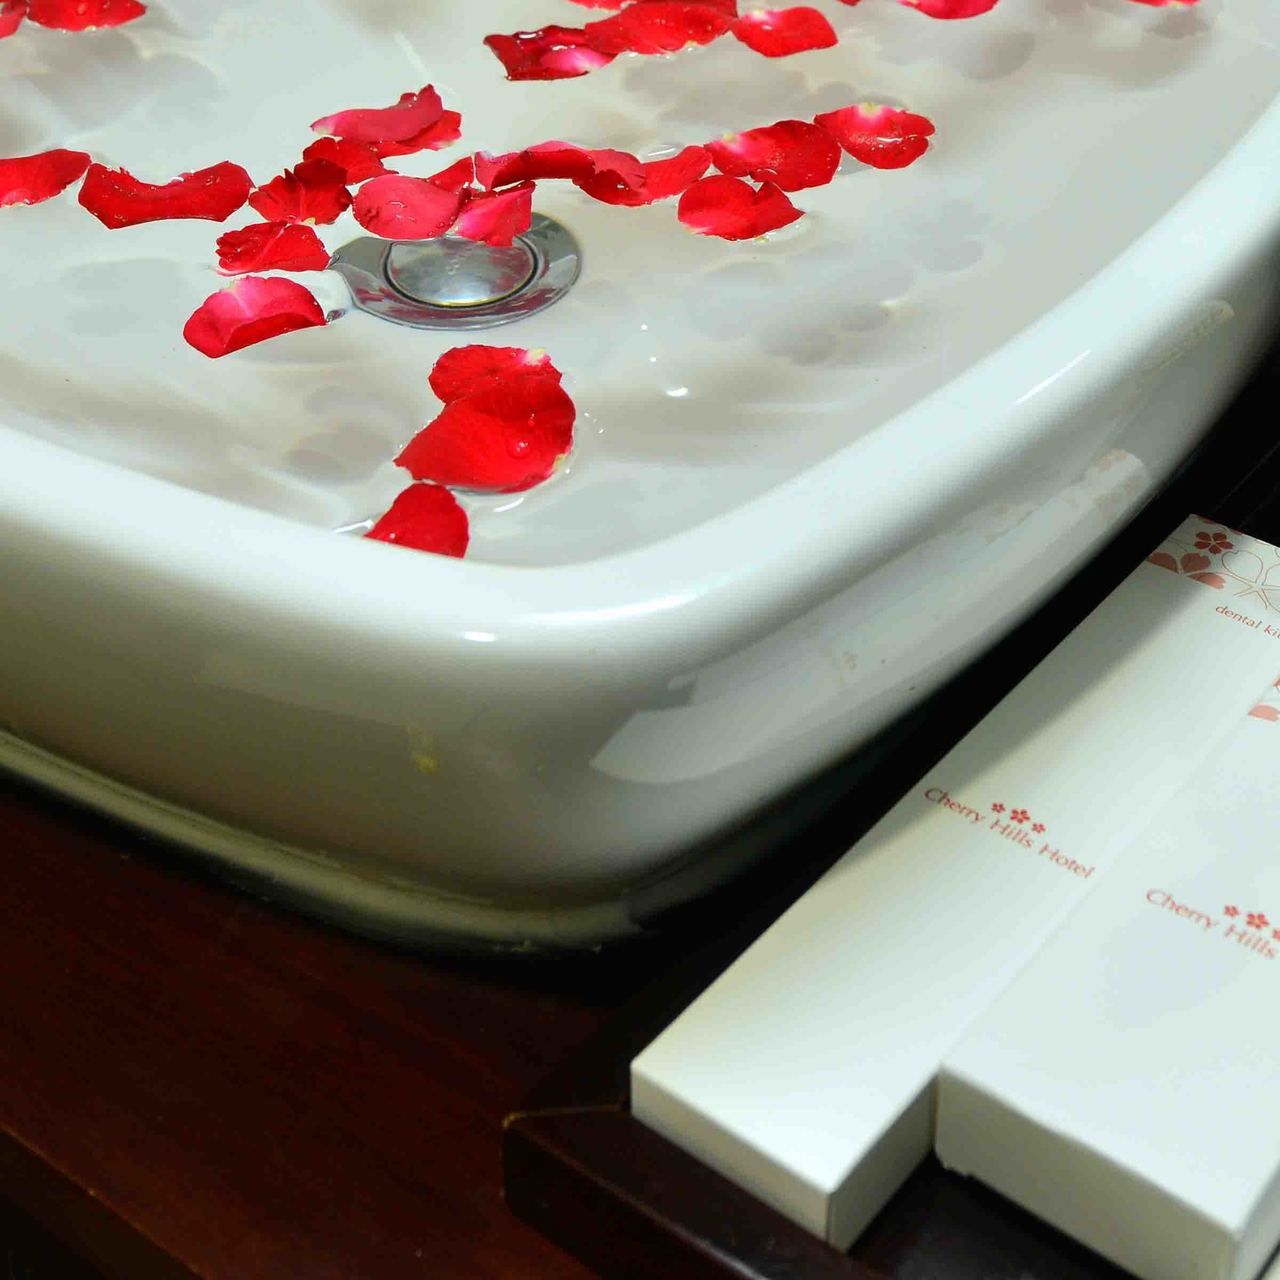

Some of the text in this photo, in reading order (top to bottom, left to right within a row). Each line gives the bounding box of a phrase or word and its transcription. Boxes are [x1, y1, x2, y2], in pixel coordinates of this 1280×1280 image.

[1215, 605, 1263, 629] dental
[924, 787, 1095, 878] Cherry Hills Hotel
[1146, 889, 1219, 930] Cherry
[1225, 924, 1276, 959] Hills
